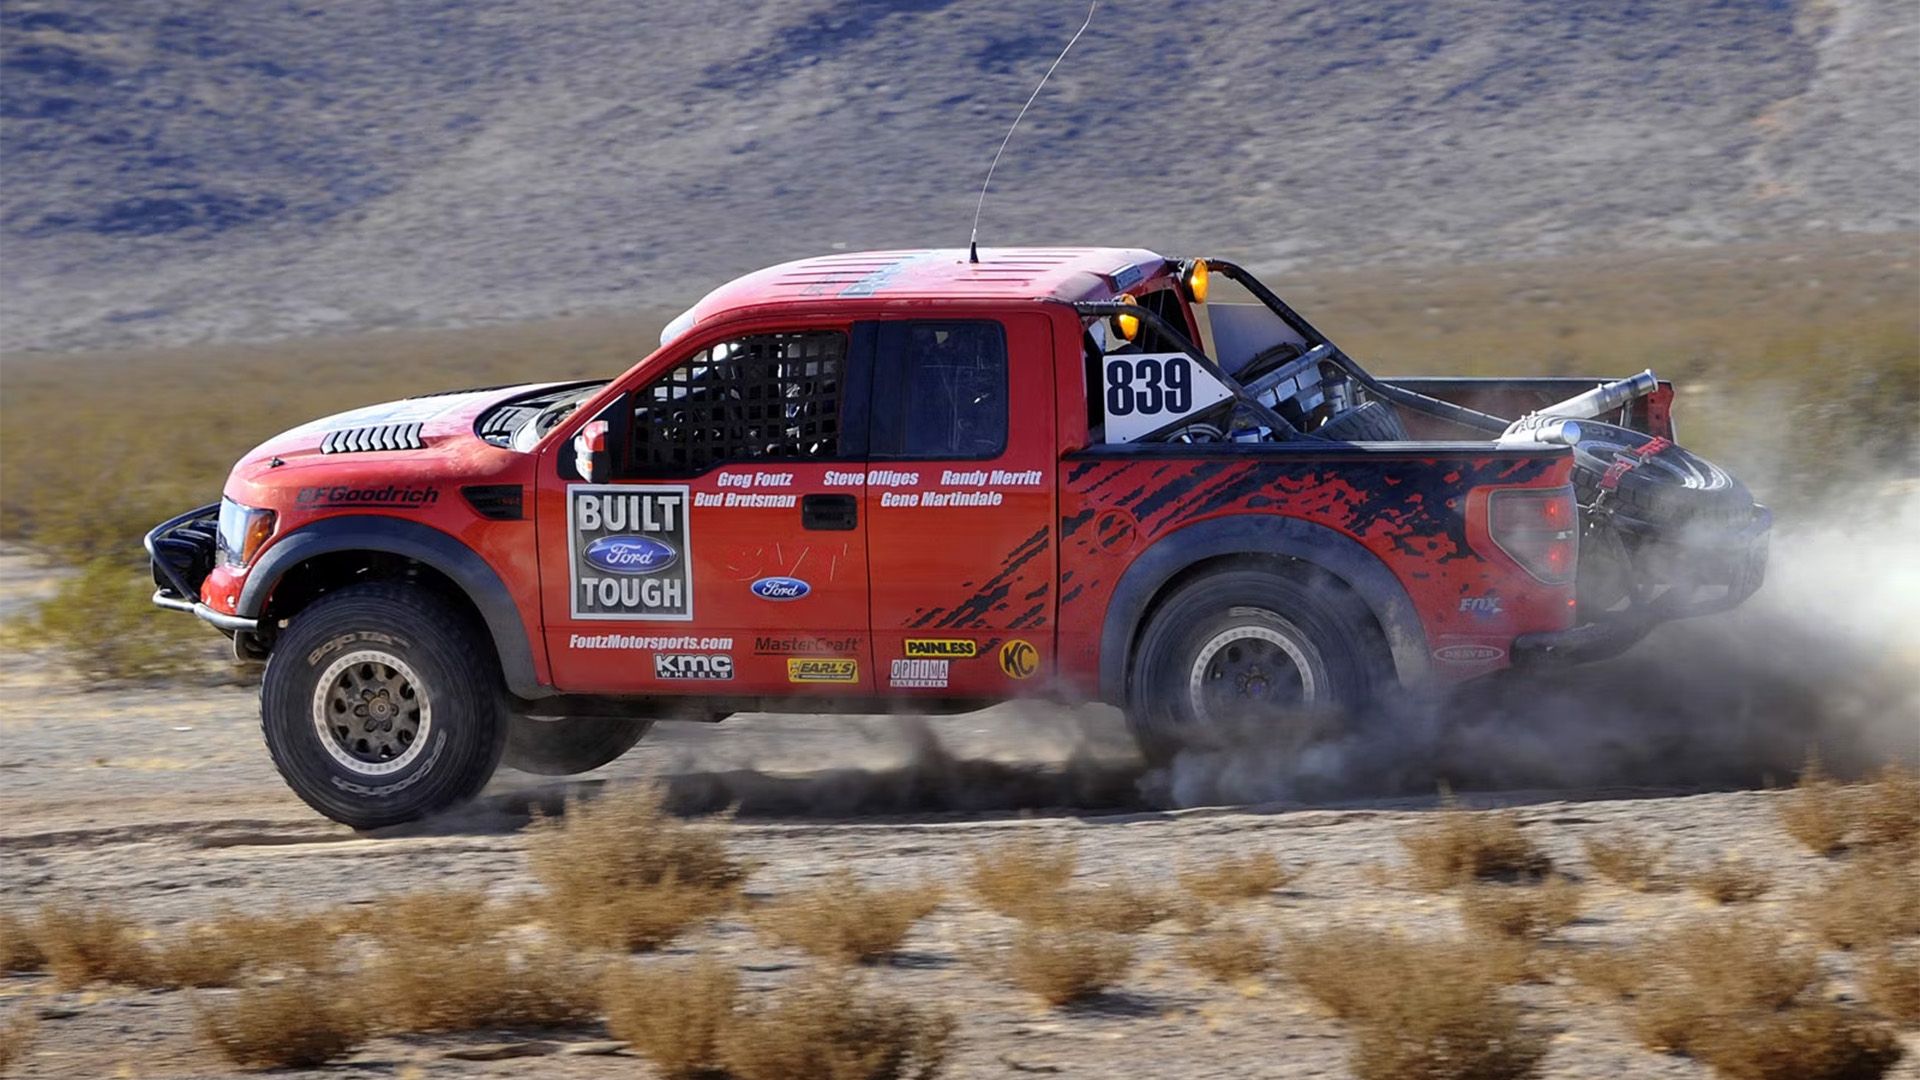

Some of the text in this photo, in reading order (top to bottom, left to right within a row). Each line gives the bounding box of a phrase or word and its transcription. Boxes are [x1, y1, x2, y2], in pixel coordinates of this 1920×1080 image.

[1107, 358, 1192, 416] 839
[718, 472, 793, 488] Greg Foutz
[824, 470, 919, 486] Steve Olliges
[941, 470, 1042, 486] Randy Merritt
[694, 492, 796, 508] Bud Brutsman
[881, 491, 1003, 507] Gene Martindale
[578, 494, 681, 532] BUILT
[605, 543, 654, 565] Ford
[581, 577, 682, 608] TOUGH
[762, 581, 799, 597] Ford
[1459, 597, 1500, 612] FOX
[569, 635, 733, 651] FoutzMotorsports.com
[755, 637, 859, 652] MasterCraft
[908, 642, 974, 654] PAINLESS
[655, 655, 731, 672] KMC
[800, 662, 852, 673] EARL'S
[1003, 642, 1035, 677] KC
[891, 660, 948, 680] OPTIMA
